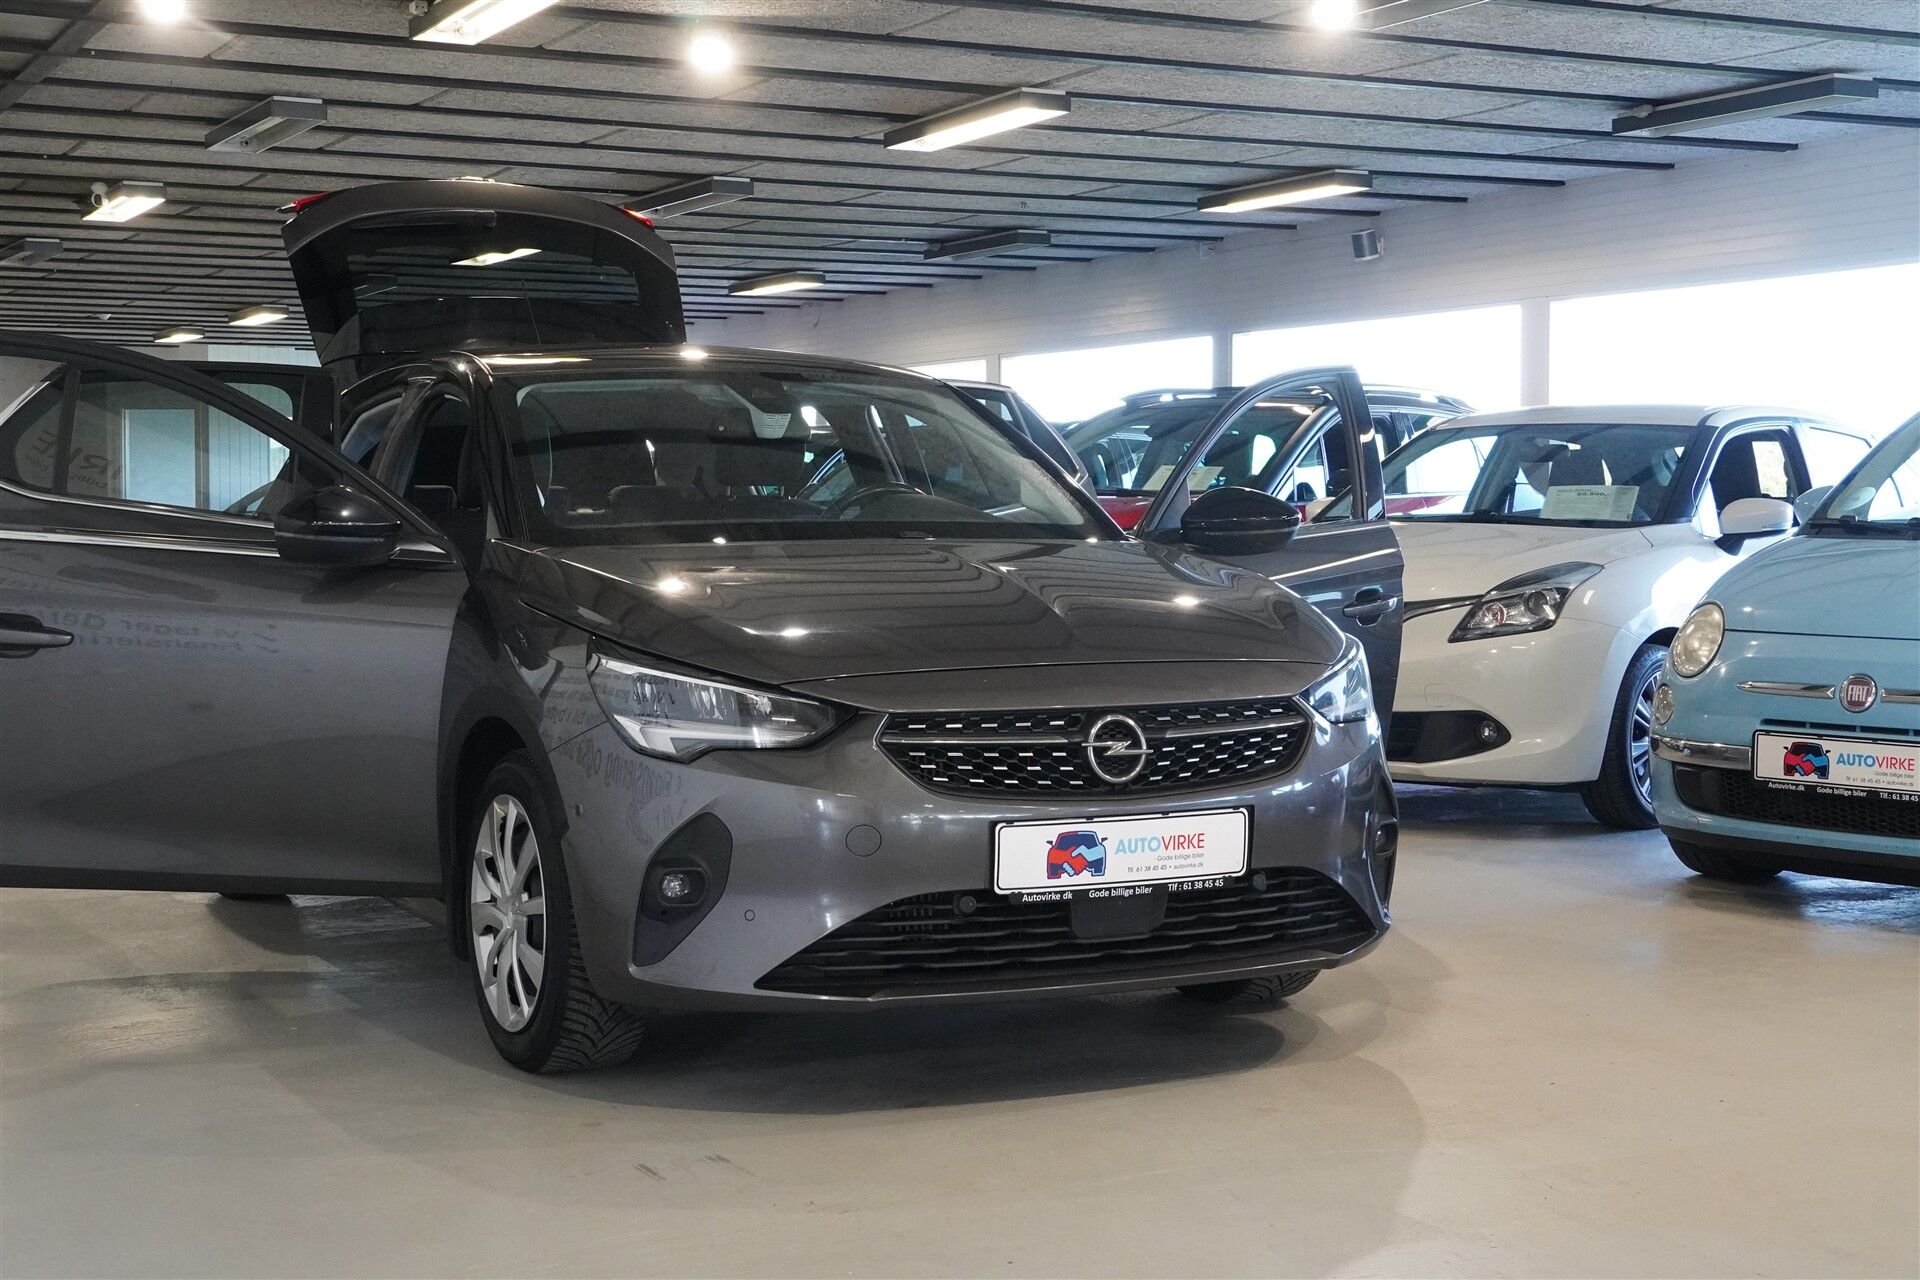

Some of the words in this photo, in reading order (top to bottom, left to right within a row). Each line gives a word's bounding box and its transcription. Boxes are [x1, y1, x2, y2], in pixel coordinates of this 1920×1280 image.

[1848, 684, 1869, 702] FIAT
[1836, 752, 1914, 772] AUTOVIRKE
[1768, 782, 1805, 791] Autovirke.dk
[1833, 788, 1852, 796] billige
[1114, 832, 1205, 855] AUTOVIRKE
[1183, 882, 1192, 890] 61
[1193, 881, 1203, 889] 38
[1204, 880, 1213, 888] 45
[1214, 879, 1224, 887] 45
[1089, 889, 1110, 898] Gode
[1111, 888, 1134, 897] billige
[1136, 886, 1152, 895] biler
